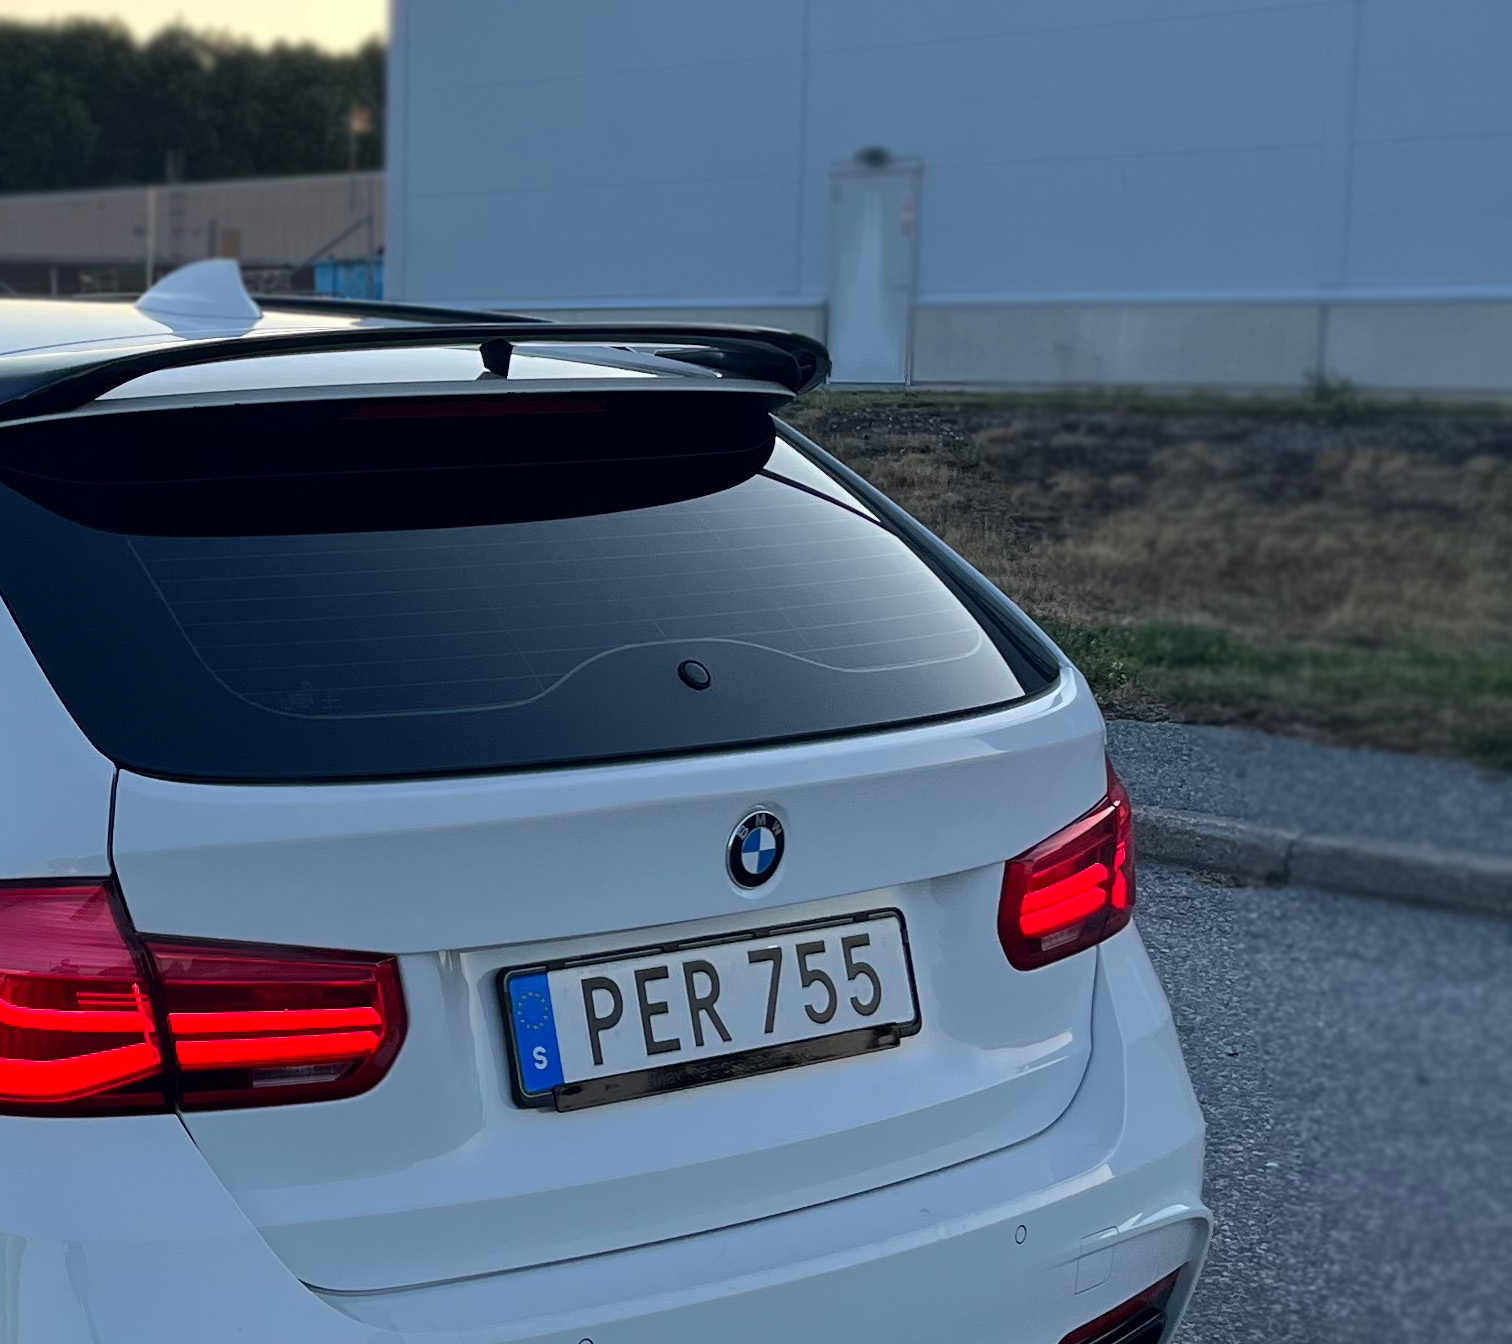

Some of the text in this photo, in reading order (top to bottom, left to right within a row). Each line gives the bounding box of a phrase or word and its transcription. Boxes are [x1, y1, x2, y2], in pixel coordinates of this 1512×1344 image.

[736, 813, 783, 841] BMW
[580, 933, 882, 1066] PER 755
[532, 1045, 548, 1070] S
